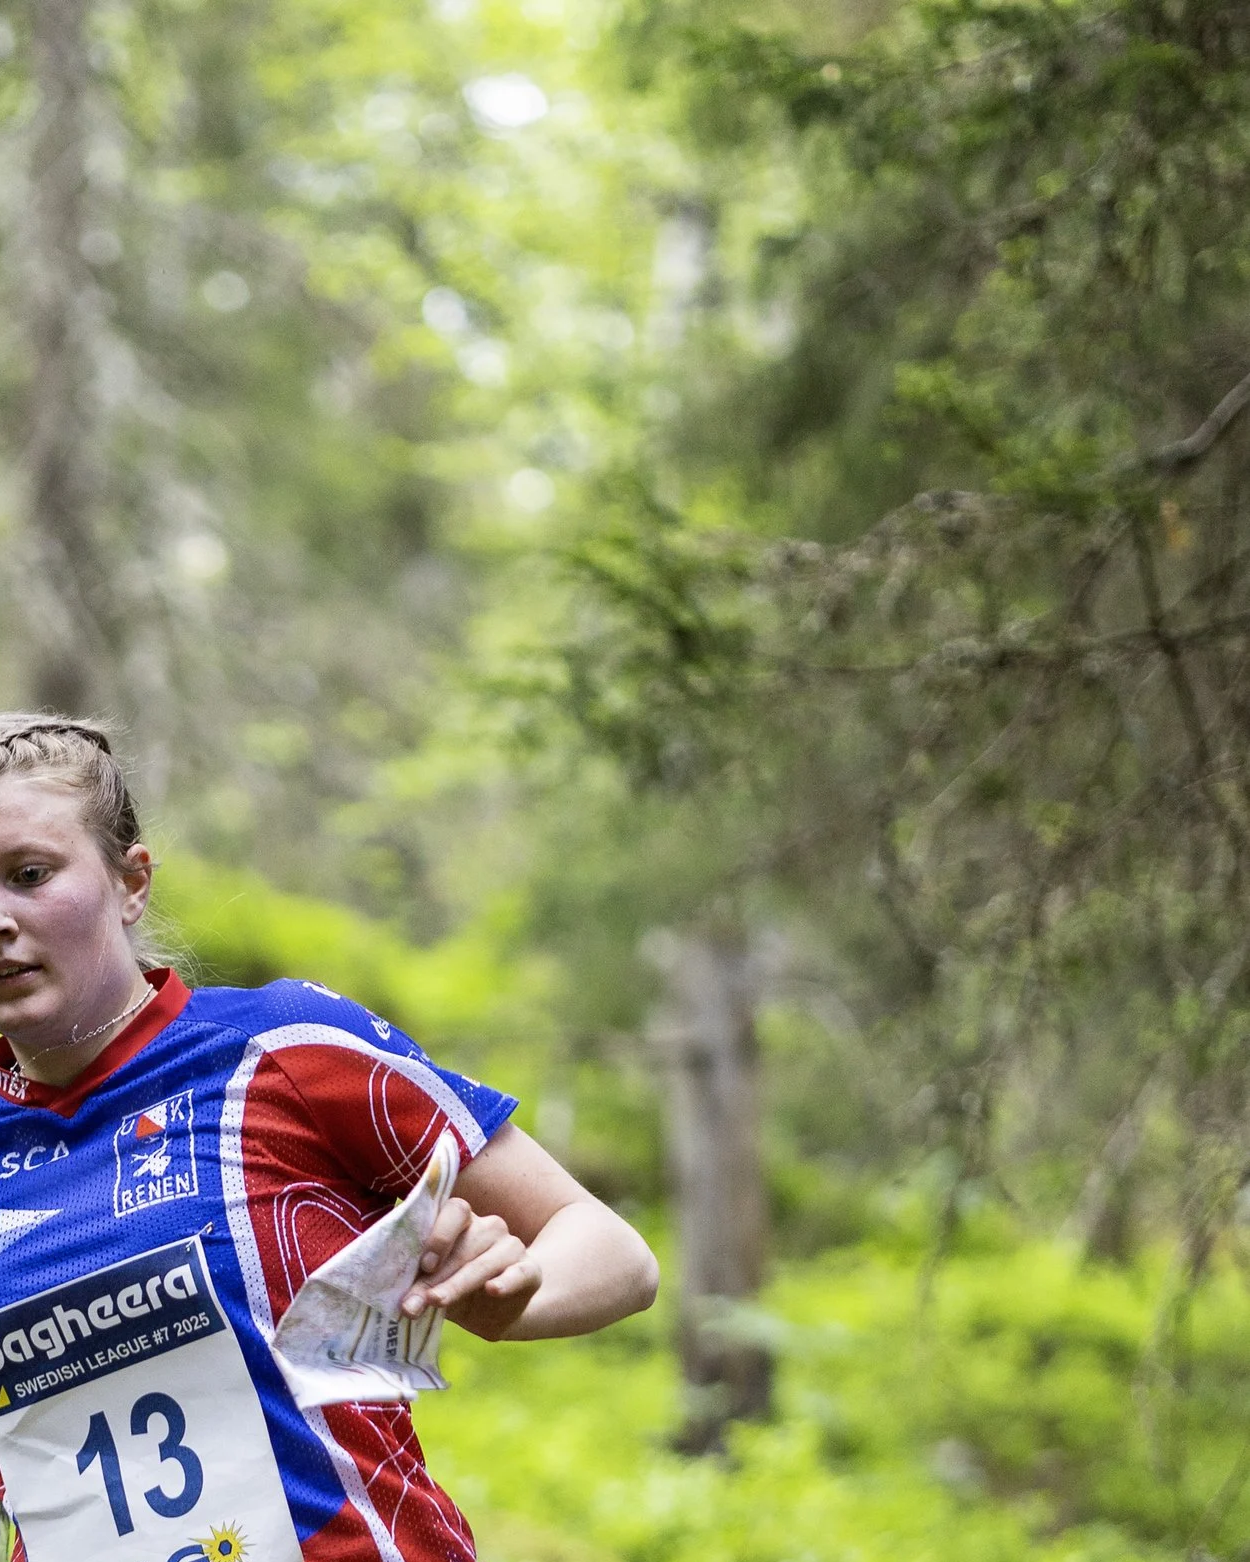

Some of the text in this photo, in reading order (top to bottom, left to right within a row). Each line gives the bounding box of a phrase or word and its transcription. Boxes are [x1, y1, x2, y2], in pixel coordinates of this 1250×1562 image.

[170, 1098, 185, 1122] K
[0, 1140, 70, 1179] SCA
[121, 1172, 191, 1211] RENEN
[14, 1311, 211, 1398] SWEDISH LEAGUE #7 2025
[76, 1391, 204, 1537] 13
